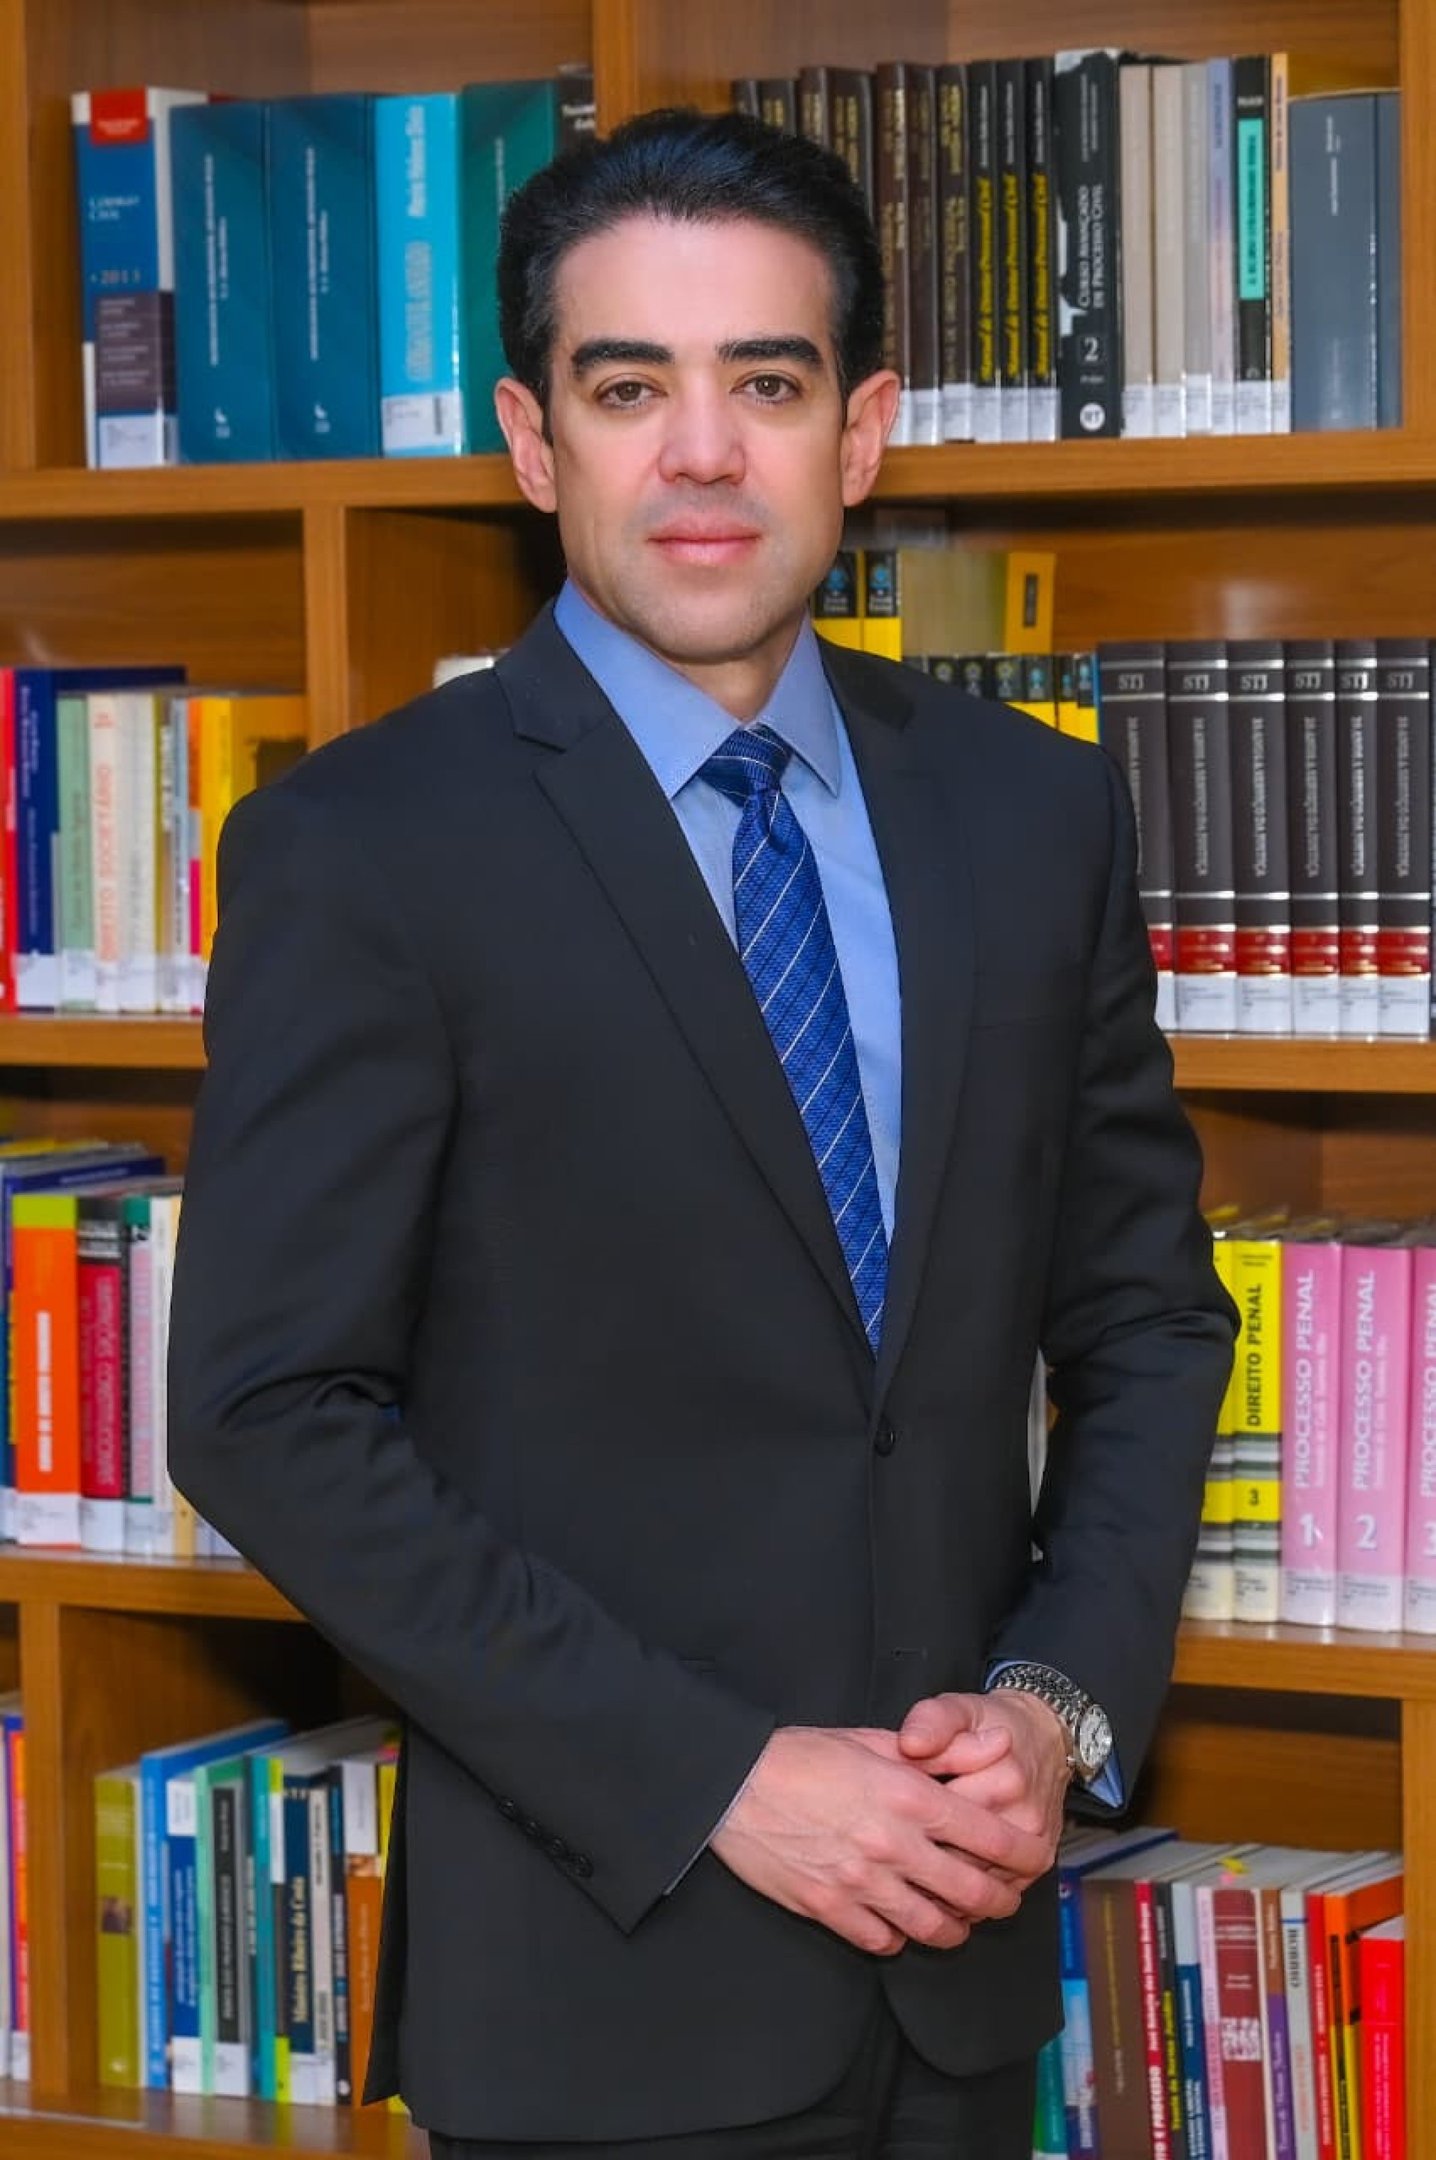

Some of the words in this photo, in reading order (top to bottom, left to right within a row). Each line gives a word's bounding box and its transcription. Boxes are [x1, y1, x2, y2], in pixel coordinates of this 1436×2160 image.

[1084, 336, 1099, 362] 2
[1118, 672, 1145, 691] STJ
[1183, 674, 1210, 691] STJ
[1240, 674, 1268, 690] STJ
[1295, 672, 1321, 689] STJ
[1341, 671, 1368, 690] STJ
[1387, 671, 1413, 689] STJ
[1246, 1284, 1261, 1345] PENAL
[1296, 1270, 1313, 1350] PENAL
[1355, 1271, 1376, 1351] PENAL
[1246, 1353, 1261, 1426] DIREITO
[1295, 1359, 1312, 1488] PROCESSO
[1353, 1360, 1372, 1490] PROCESSO
[1249, 1490, 1260, 1506] 3
[1301, 1512, 1316, 1548] 1
[1355, 1513, 1378, 1551] 2
[290, 1877, 305, 1909] Costa
[1149, 2065, 1165, 2128] PROCESSO
